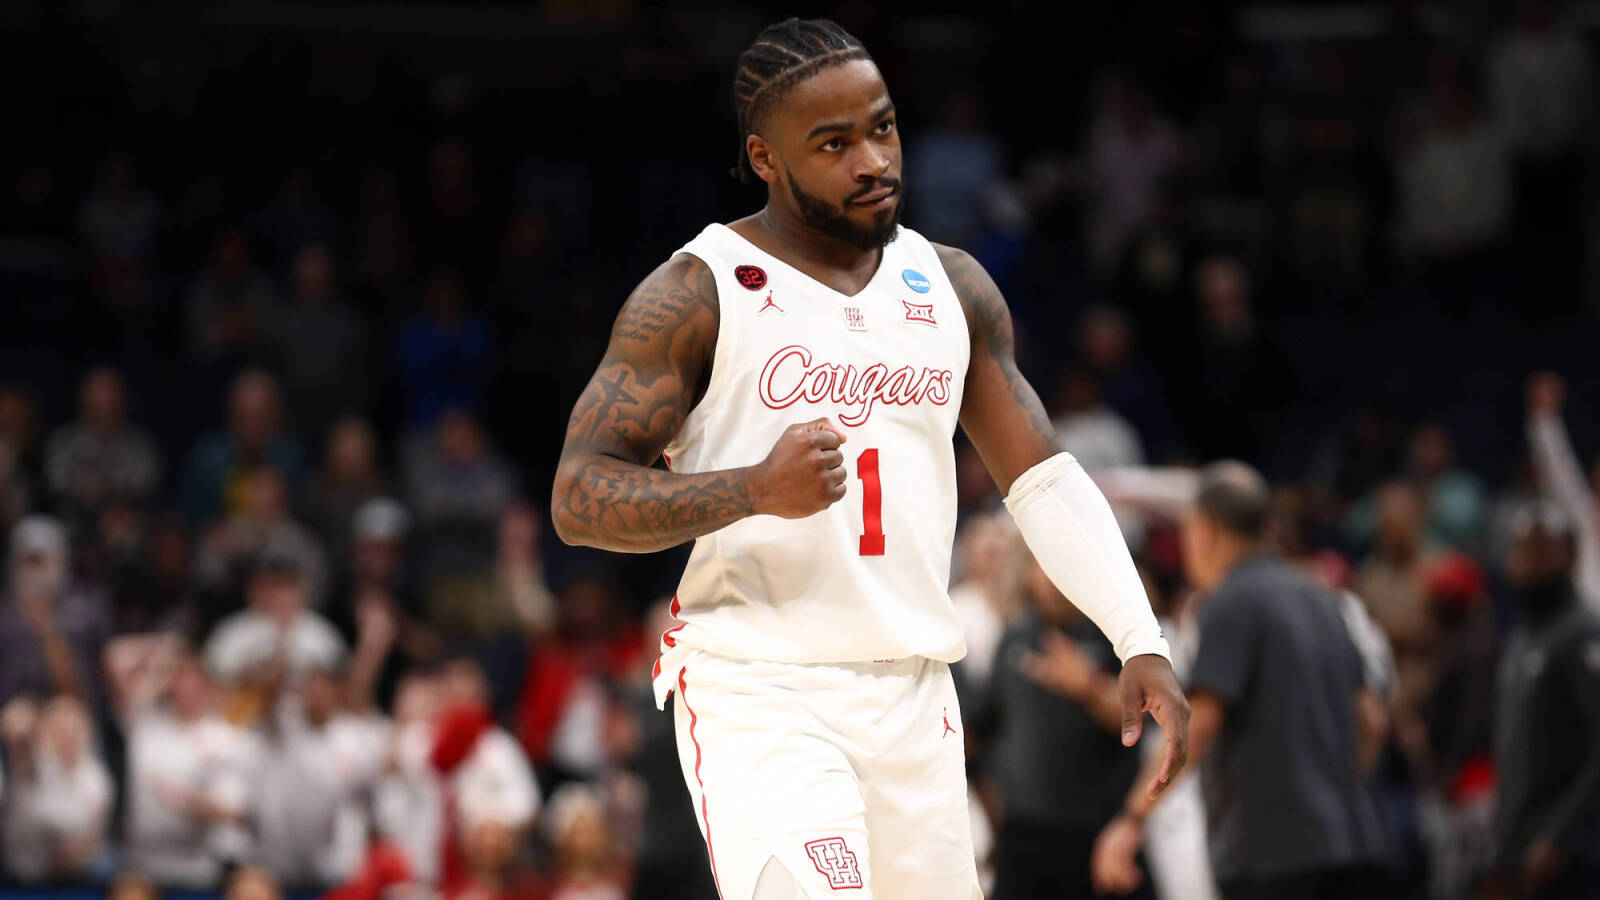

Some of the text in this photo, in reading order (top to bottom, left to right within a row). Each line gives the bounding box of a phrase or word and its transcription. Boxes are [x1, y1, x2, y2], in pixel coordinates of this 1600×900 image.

[739, 270, 763, 285] 32
[759, 345, 952, 427] Cougars
[857, 448, 885, 556] 1
[806, 838, 861, 888] UH
